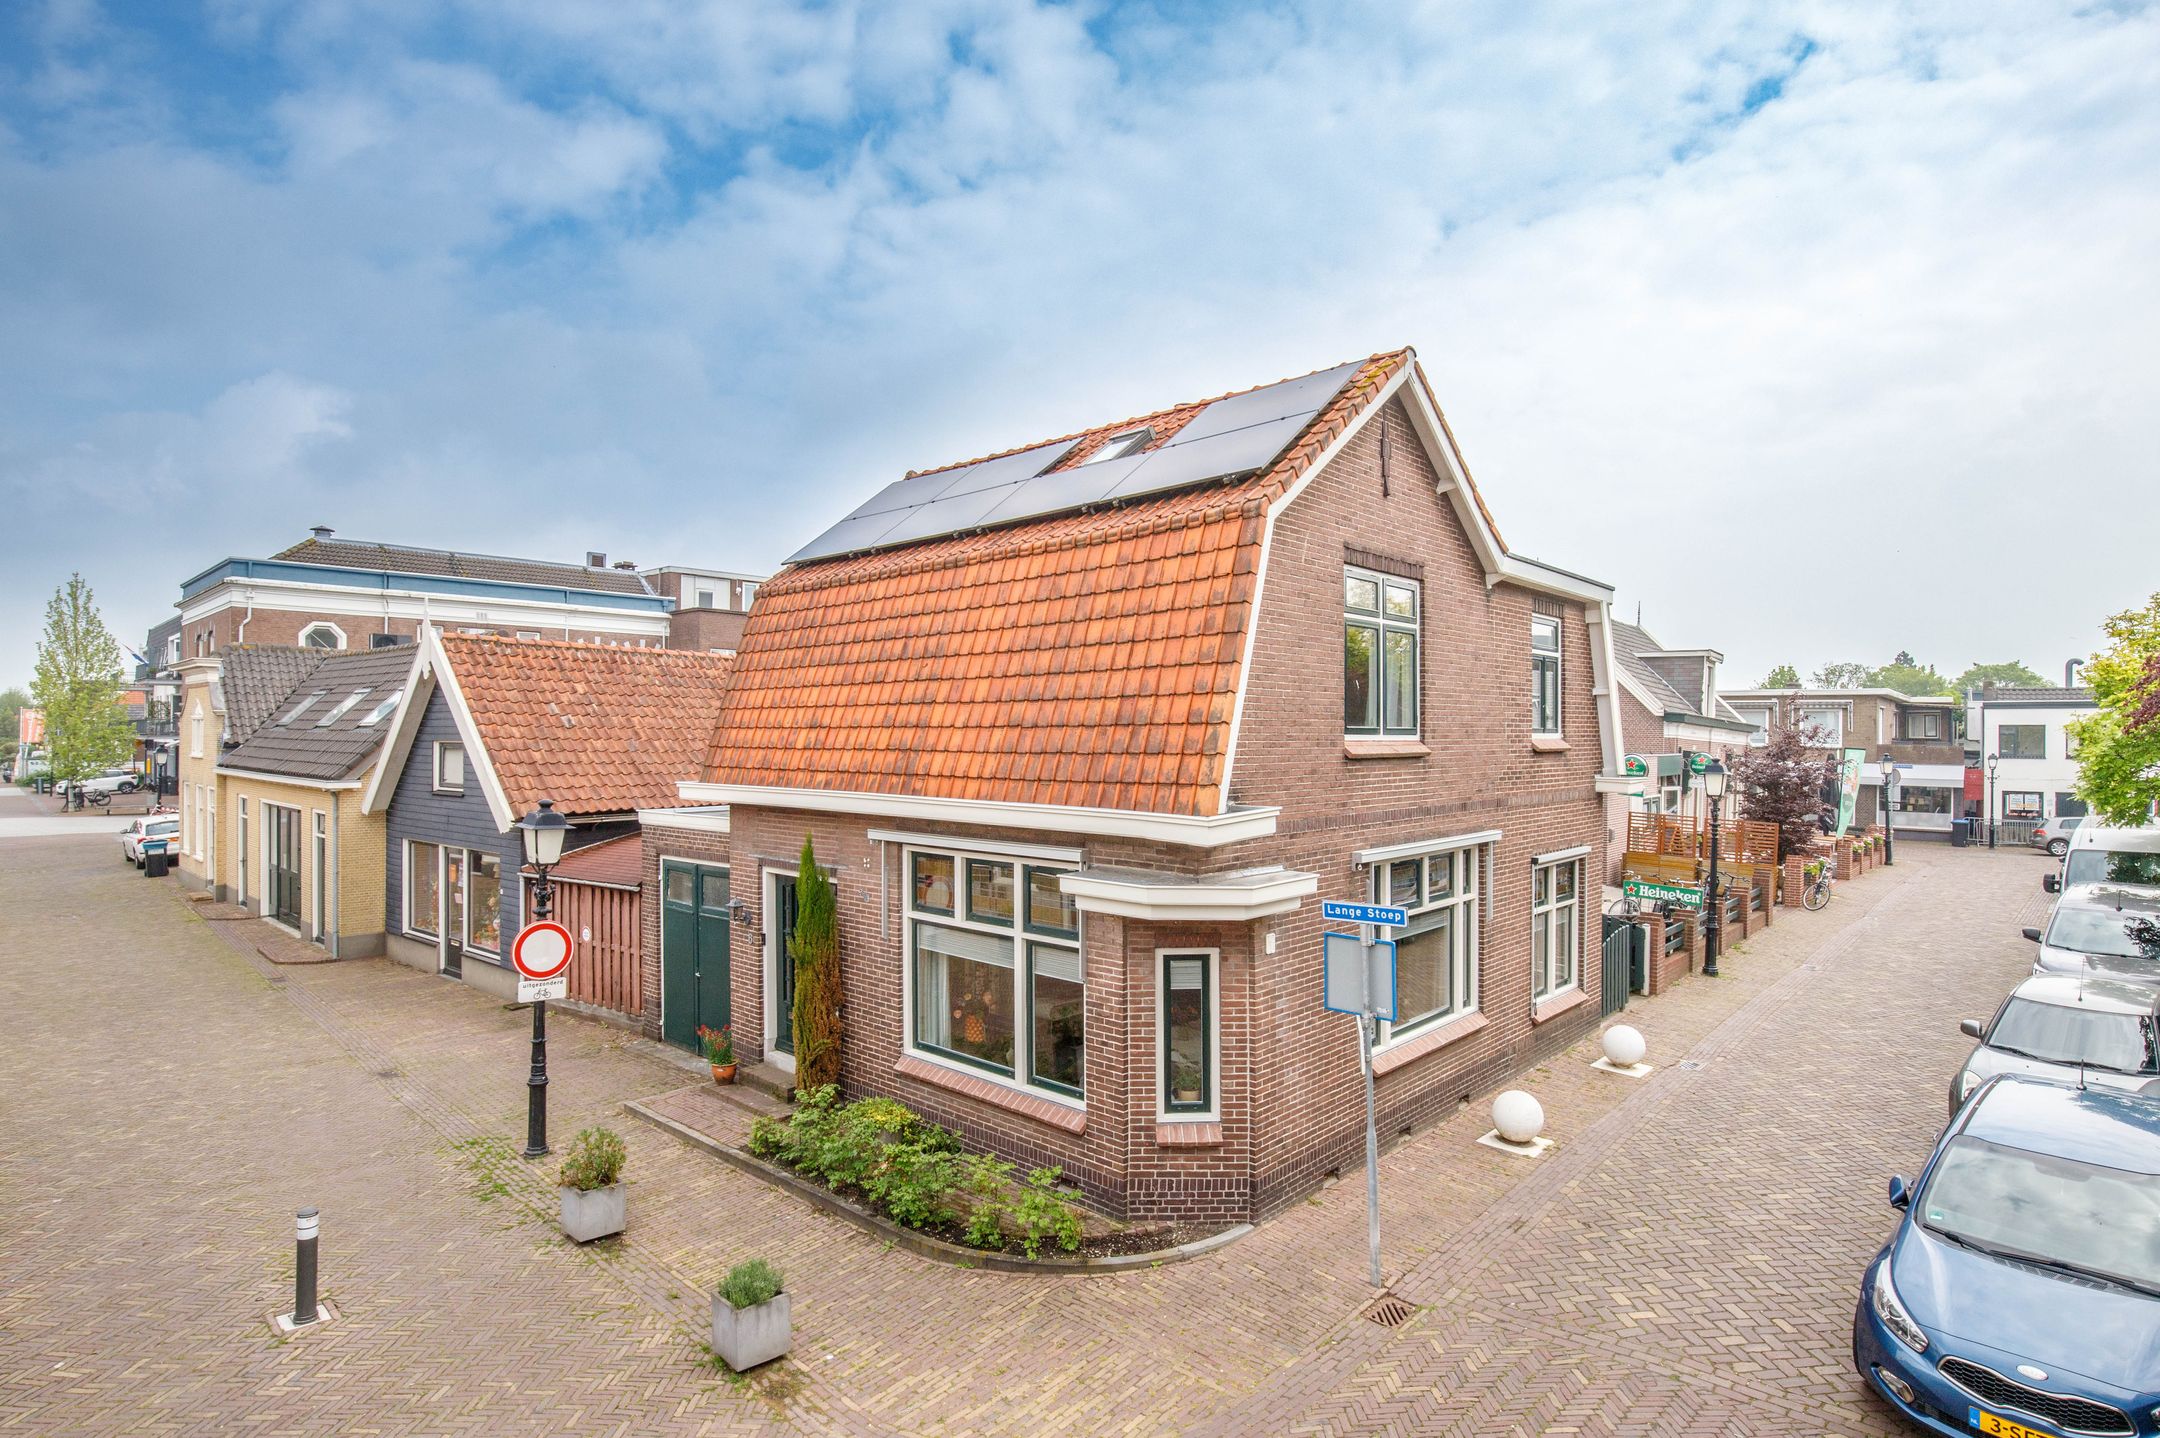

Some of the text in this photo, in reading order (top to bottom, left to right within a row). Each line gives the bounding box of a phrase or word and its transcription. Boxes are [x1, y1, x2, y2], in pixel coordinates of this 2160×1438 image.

[1639, 885, 1700, 904] Heineken
[1327, 904, 1402, 923] Lange Stoep
[522, 979, 564, 989] uitgezonderd
